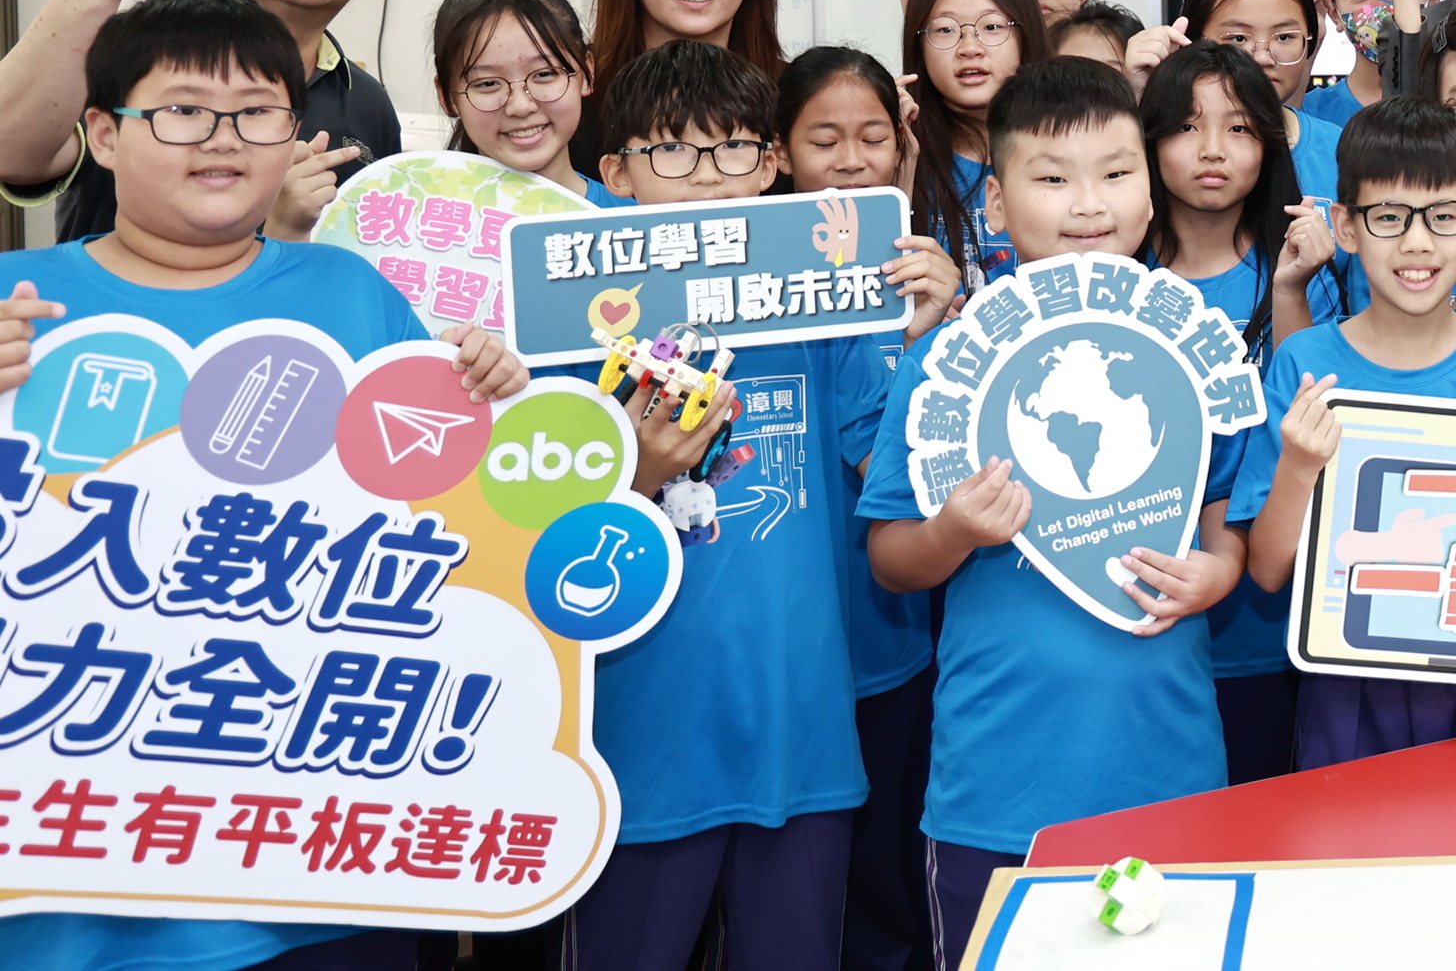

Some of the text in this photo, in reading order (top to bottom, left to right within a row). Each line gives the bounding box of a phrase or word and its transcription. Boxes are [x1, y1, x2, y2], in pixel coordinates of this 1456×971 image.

[544, 216, 749, 280] 數位學習
[378, 256, 506, 328] 學習
[685, 264, 884, 325] 開啟未來
[745, 389, 794, 414] 漳興
[487, 431, 615, 482] abc
[1037, 486, 1183, 538] Let Digital Learning
[1052, 502, 1183, 552] Change the World
[0, 617, 496, 769] 力全開!
[0, 778, 558, 885] 生有平板達標
